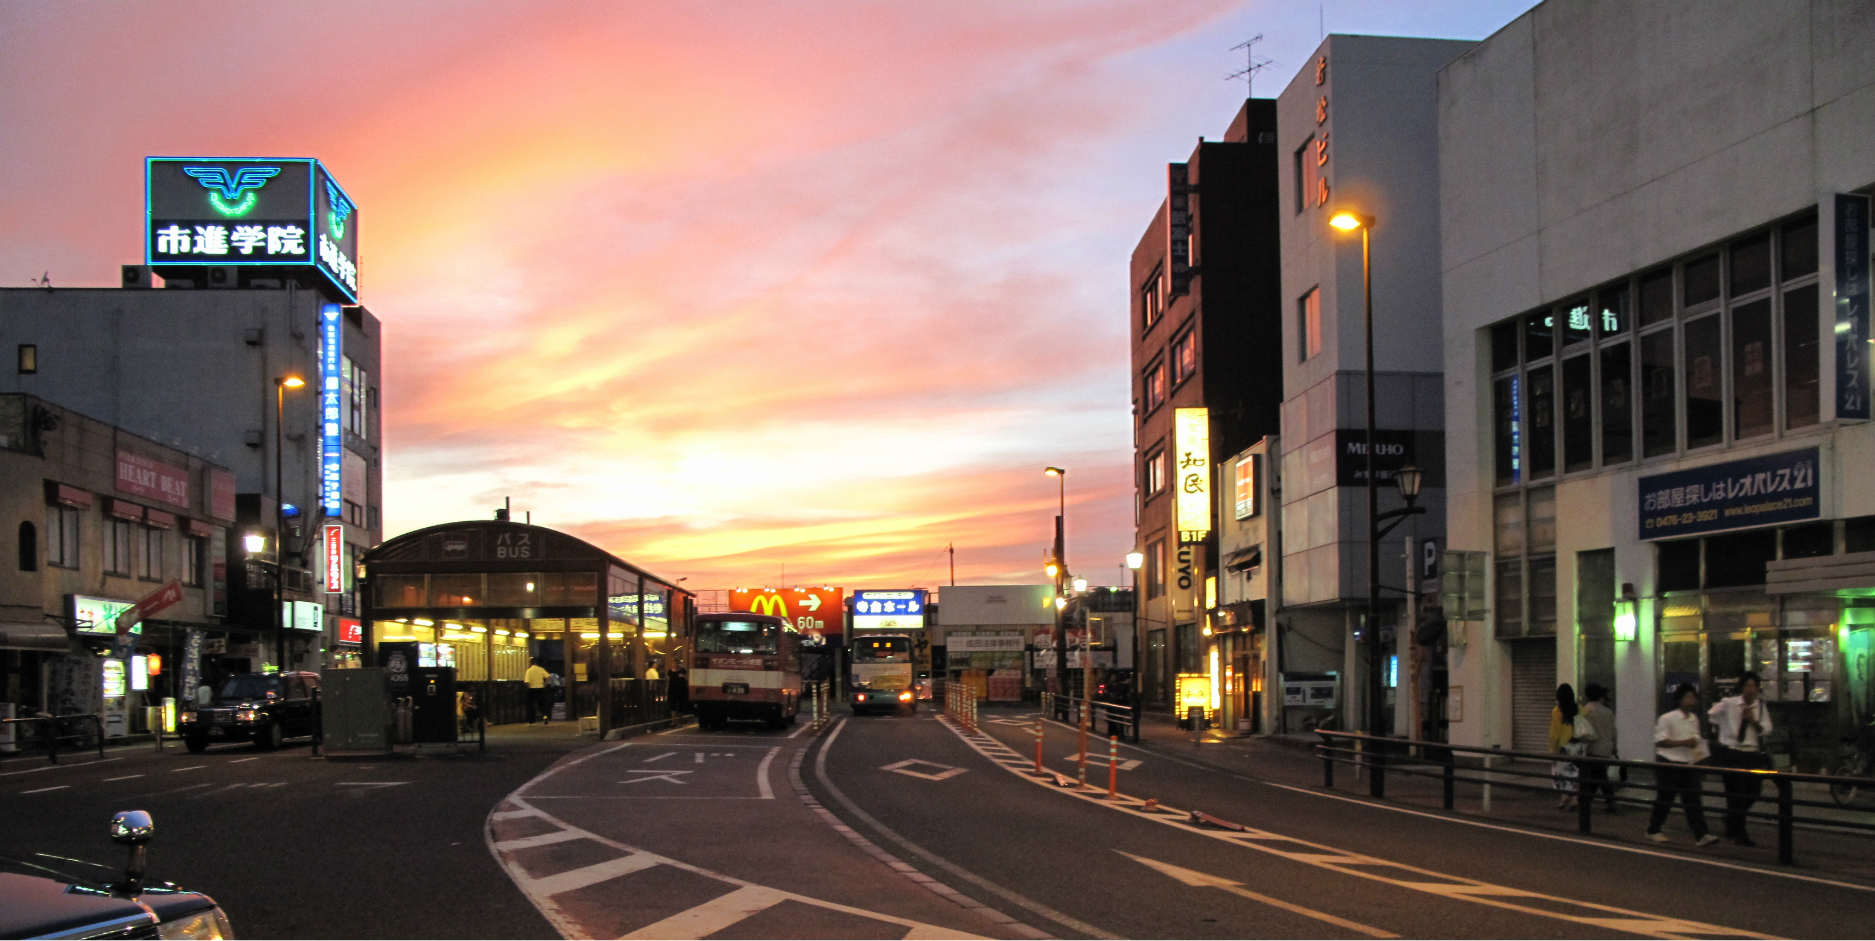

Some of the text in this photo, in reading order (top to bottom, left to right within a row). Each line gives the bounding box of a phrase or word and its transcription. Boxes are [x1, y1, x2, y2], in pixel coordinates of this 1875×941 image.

[156, 224, 306, 255] 市進学院
[1347, 443, 1404, 455] MIUHO
[119, 462, 157, 489] HEART
[160, 475, 188, 497] BEAT
[1180, 452, 1205, 494] 和民
[1644, 460, 1814, 511] お部屋探しはレオパレス21
[1656, 509, 1718, 528] 0476-23-3921
[497, 532, 531, 545] バス
[1181, 531, 1208, 542] B1F
[497, 546, 531, 559] BUS
[1424, 541, 1436, 576] P
[797, 616, 825, 629] 60m
